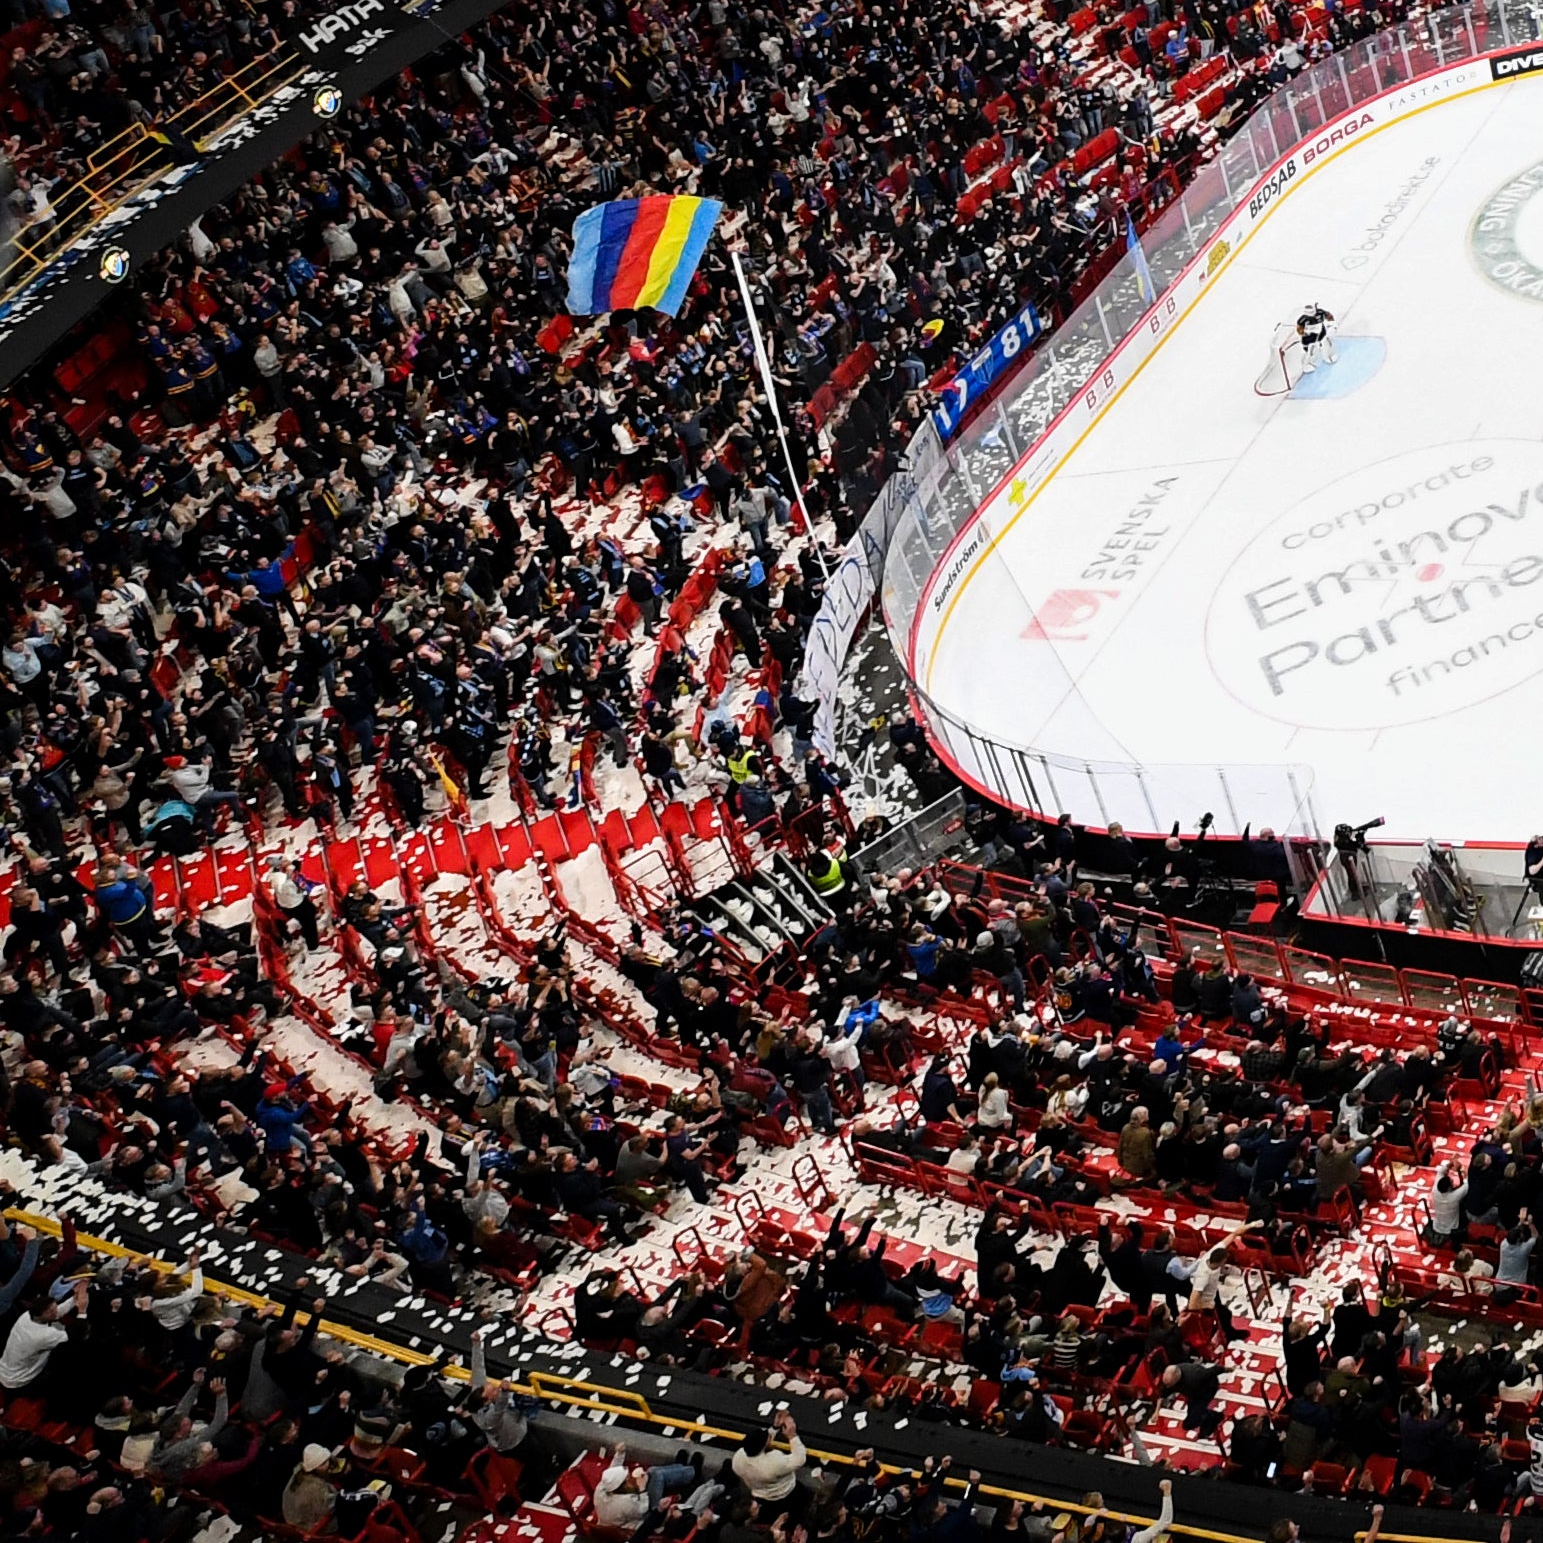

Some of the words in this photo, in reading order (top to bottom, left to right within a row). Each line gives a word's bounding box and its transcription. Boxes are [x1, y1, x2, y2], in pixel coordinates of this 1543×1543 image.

[1302, 114, 1374, 164] BORGA
[1250, 159, 1297, 218] BEDSAB
[1081, 476, 1179, 580] SVENSKA
[1281, 454, 1496, 551] corporate
[933, 540, 978, 612] Sundström
[1111, 524, 1168, 581] SPEL
